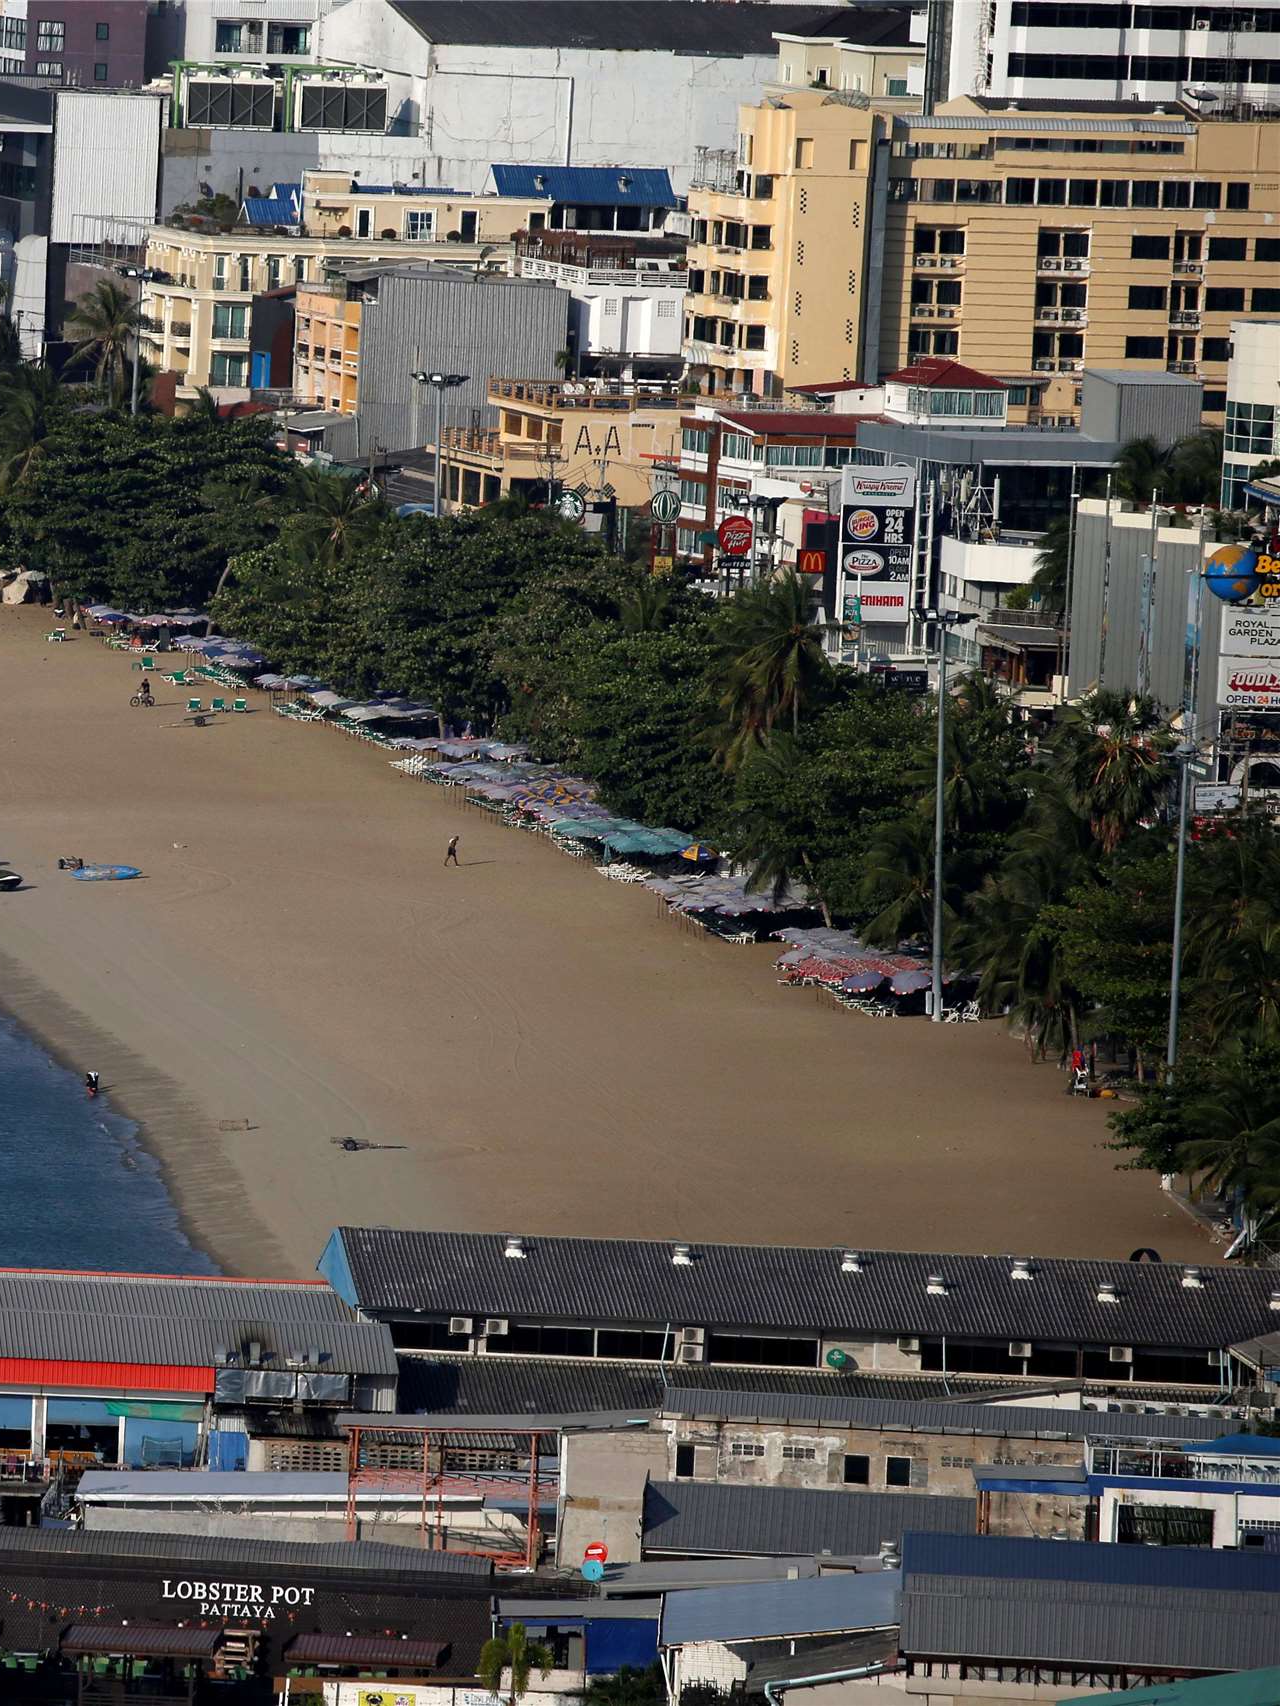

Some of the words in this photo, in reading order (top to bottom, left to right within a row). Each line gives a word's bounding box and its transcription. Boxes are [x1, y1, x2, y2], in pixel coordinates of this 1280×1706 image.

[880, 481, 904, 491] Kreme
[886, 509, 905, 518] OPEN
[852, 515, 875, 526] BURGER
[885, 517, 904, 533] 24
[852, 521, 875, 532] KING
[723, 531, 750, 543] Pizza
[884, 533, 904, 543] HRS
[728, 539, 746, 549] Hut
[889, 548, 908, 556] OPEN
[852, 556, 877, 565] PIZZA
[855, 595, 904, 607] ENIHANA
[1235, 620, 1269, 629] ROYAL
[1228, 628, 1273, 637] GARDEN
[1226, 694, 1256, 704] OPEN
[1257, 696, 1269, 705] 24
[1271, 696, 1280, 705] H
[162, 1580, 265, 1603] LOBSTER
[271, 1586, 315, 1606] POT
[200, 1602, 275, 1619] PATTAYA
